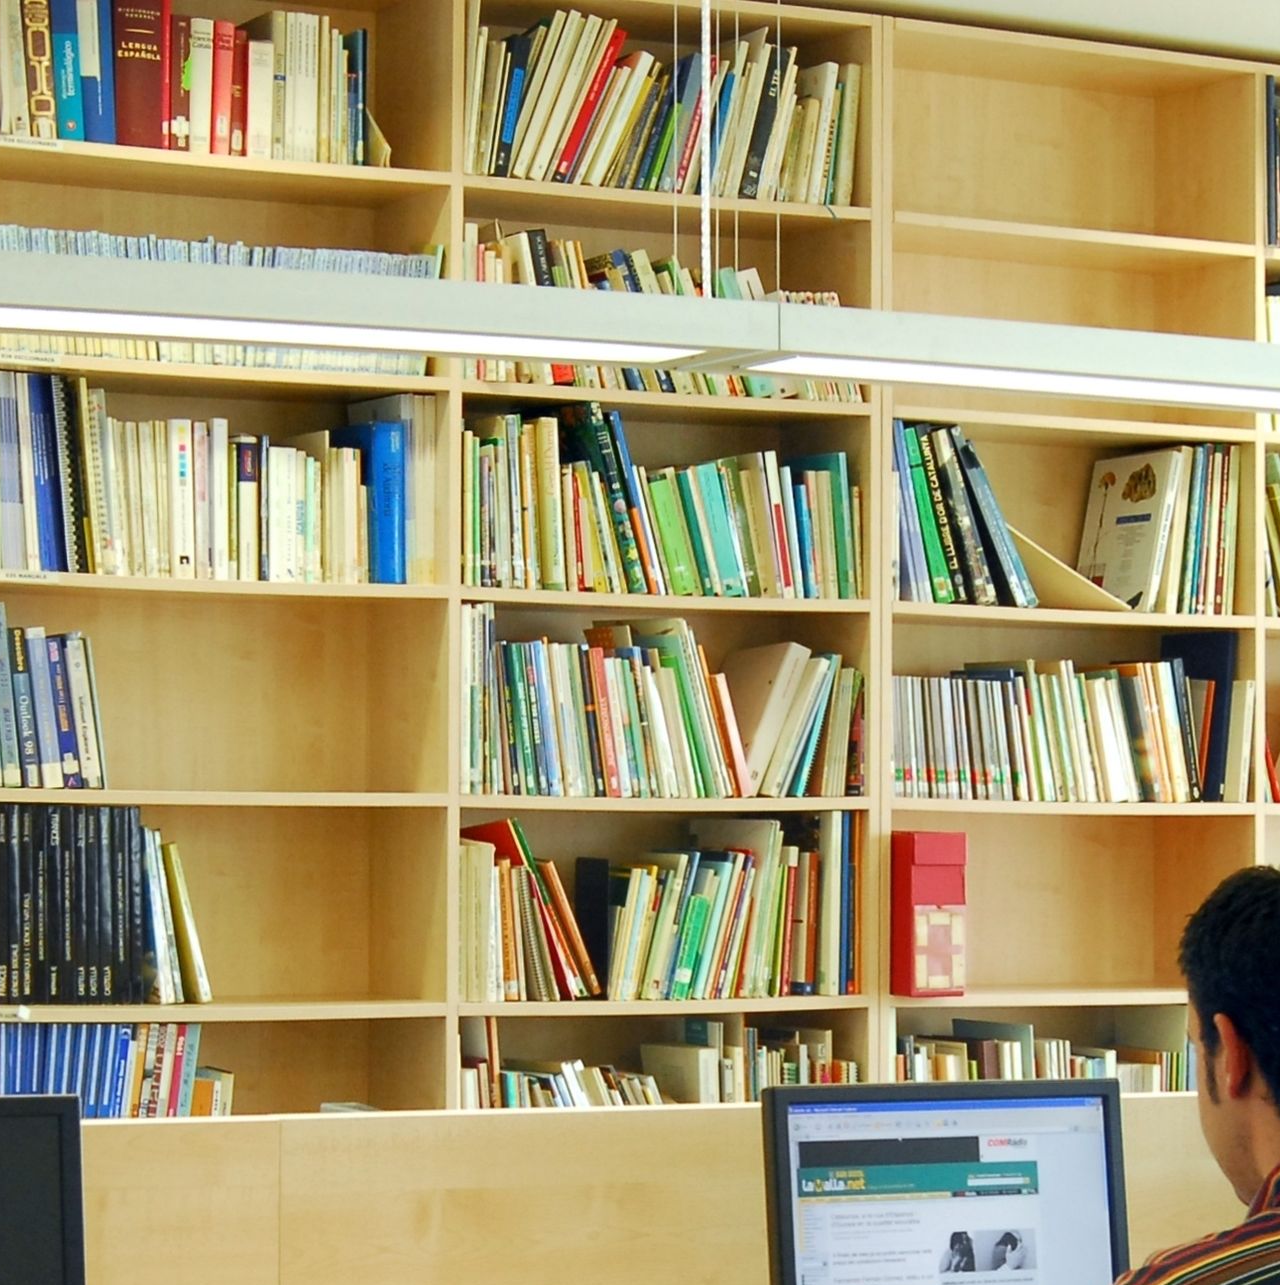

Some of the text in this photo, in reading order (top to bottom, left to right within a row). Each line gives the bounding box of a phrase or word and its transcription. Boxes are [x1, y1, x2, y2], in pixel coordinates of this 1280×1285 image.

[117, 50, 161, 61] ESPAÑOLA
[121, 41, 158, 52] LENGUA
[920, 434, 958, 570] EL LLIBRE D'OR DE CATALUNYA
[13, 629, 25, 672] Descubre
[19, 695, 34, 755] Outlook 98
